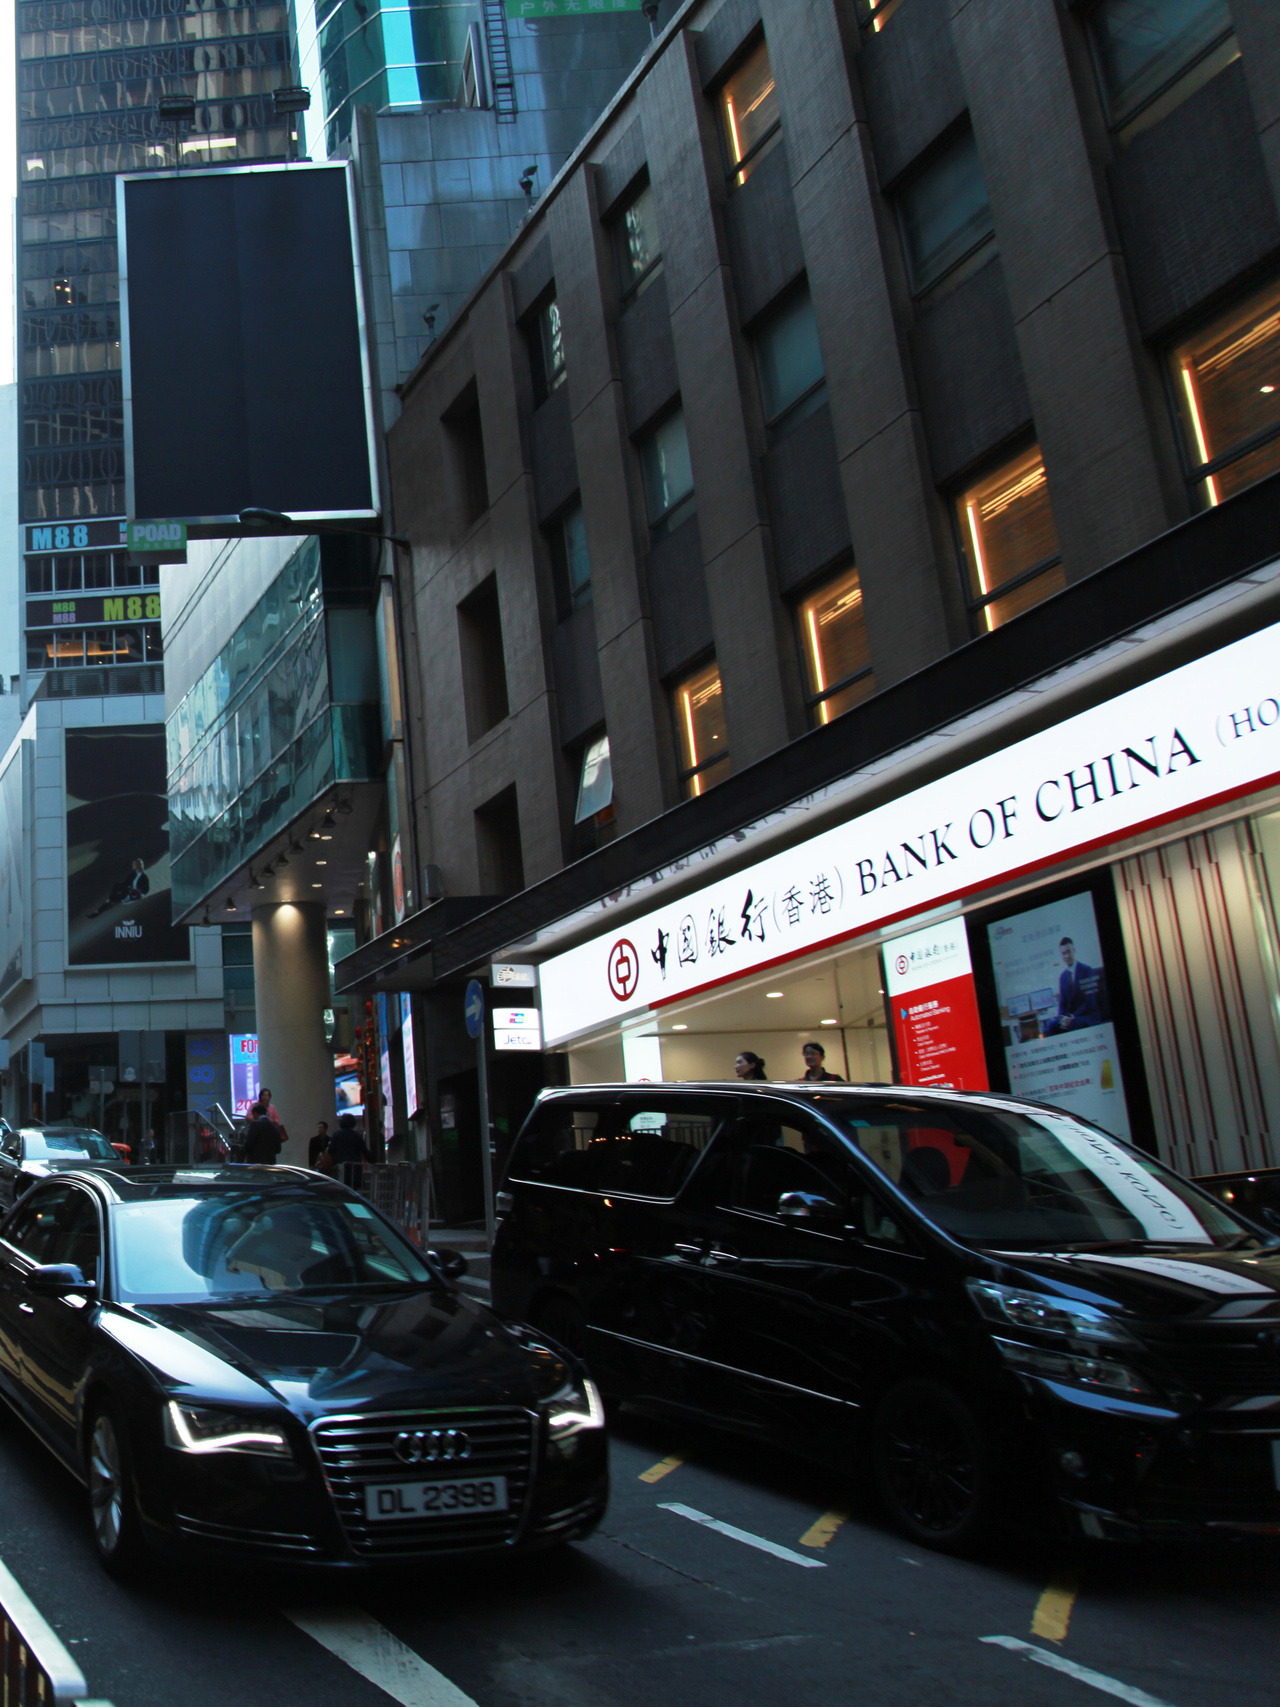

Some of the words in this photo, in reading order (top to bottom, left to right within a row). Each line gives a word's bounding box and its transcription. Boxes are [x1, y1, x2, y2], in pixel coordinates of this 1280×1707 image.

[32, 524, 89, 550] M88
[133, 523, 182, 542] POAD
[52, 601, 76, 613] M88
[52, 612, 77, 624] M88
[103, 594, 161, 622] M88
[855, 822, 957, 897] BANK
[969, 795, 1018, 849] OF
[1035, 726, 1203, 823] CHINA
[115, 925, 143, 939] INNIU
[376, 1488, 415, 1514] DL
[423, 1482, 496, 1511] 2398
